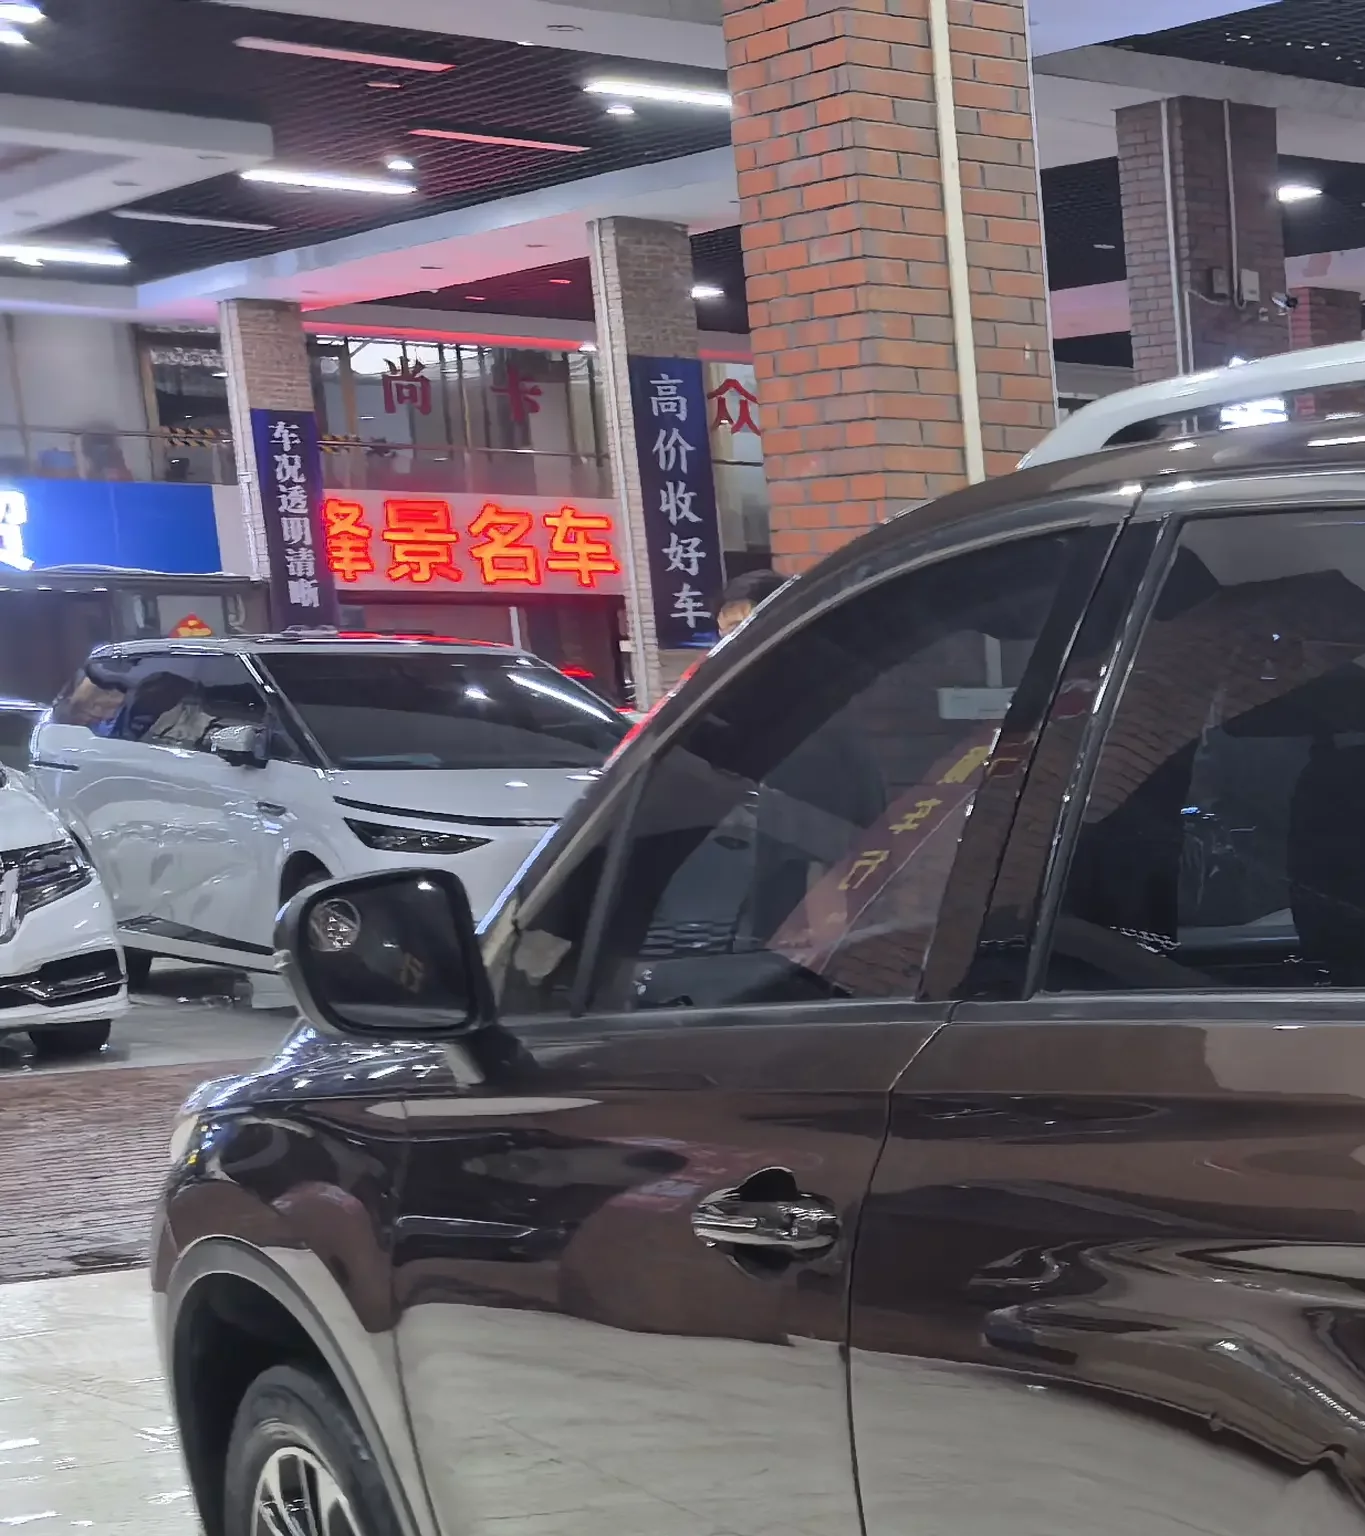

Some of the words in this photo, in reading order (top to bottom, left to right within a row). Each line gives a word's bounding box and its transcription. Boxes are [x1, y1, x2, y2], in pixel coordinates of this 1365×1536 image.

[268, 421, 320, 607] 车况透明清晰
[649, 373, 711, 628] 高价收好车
